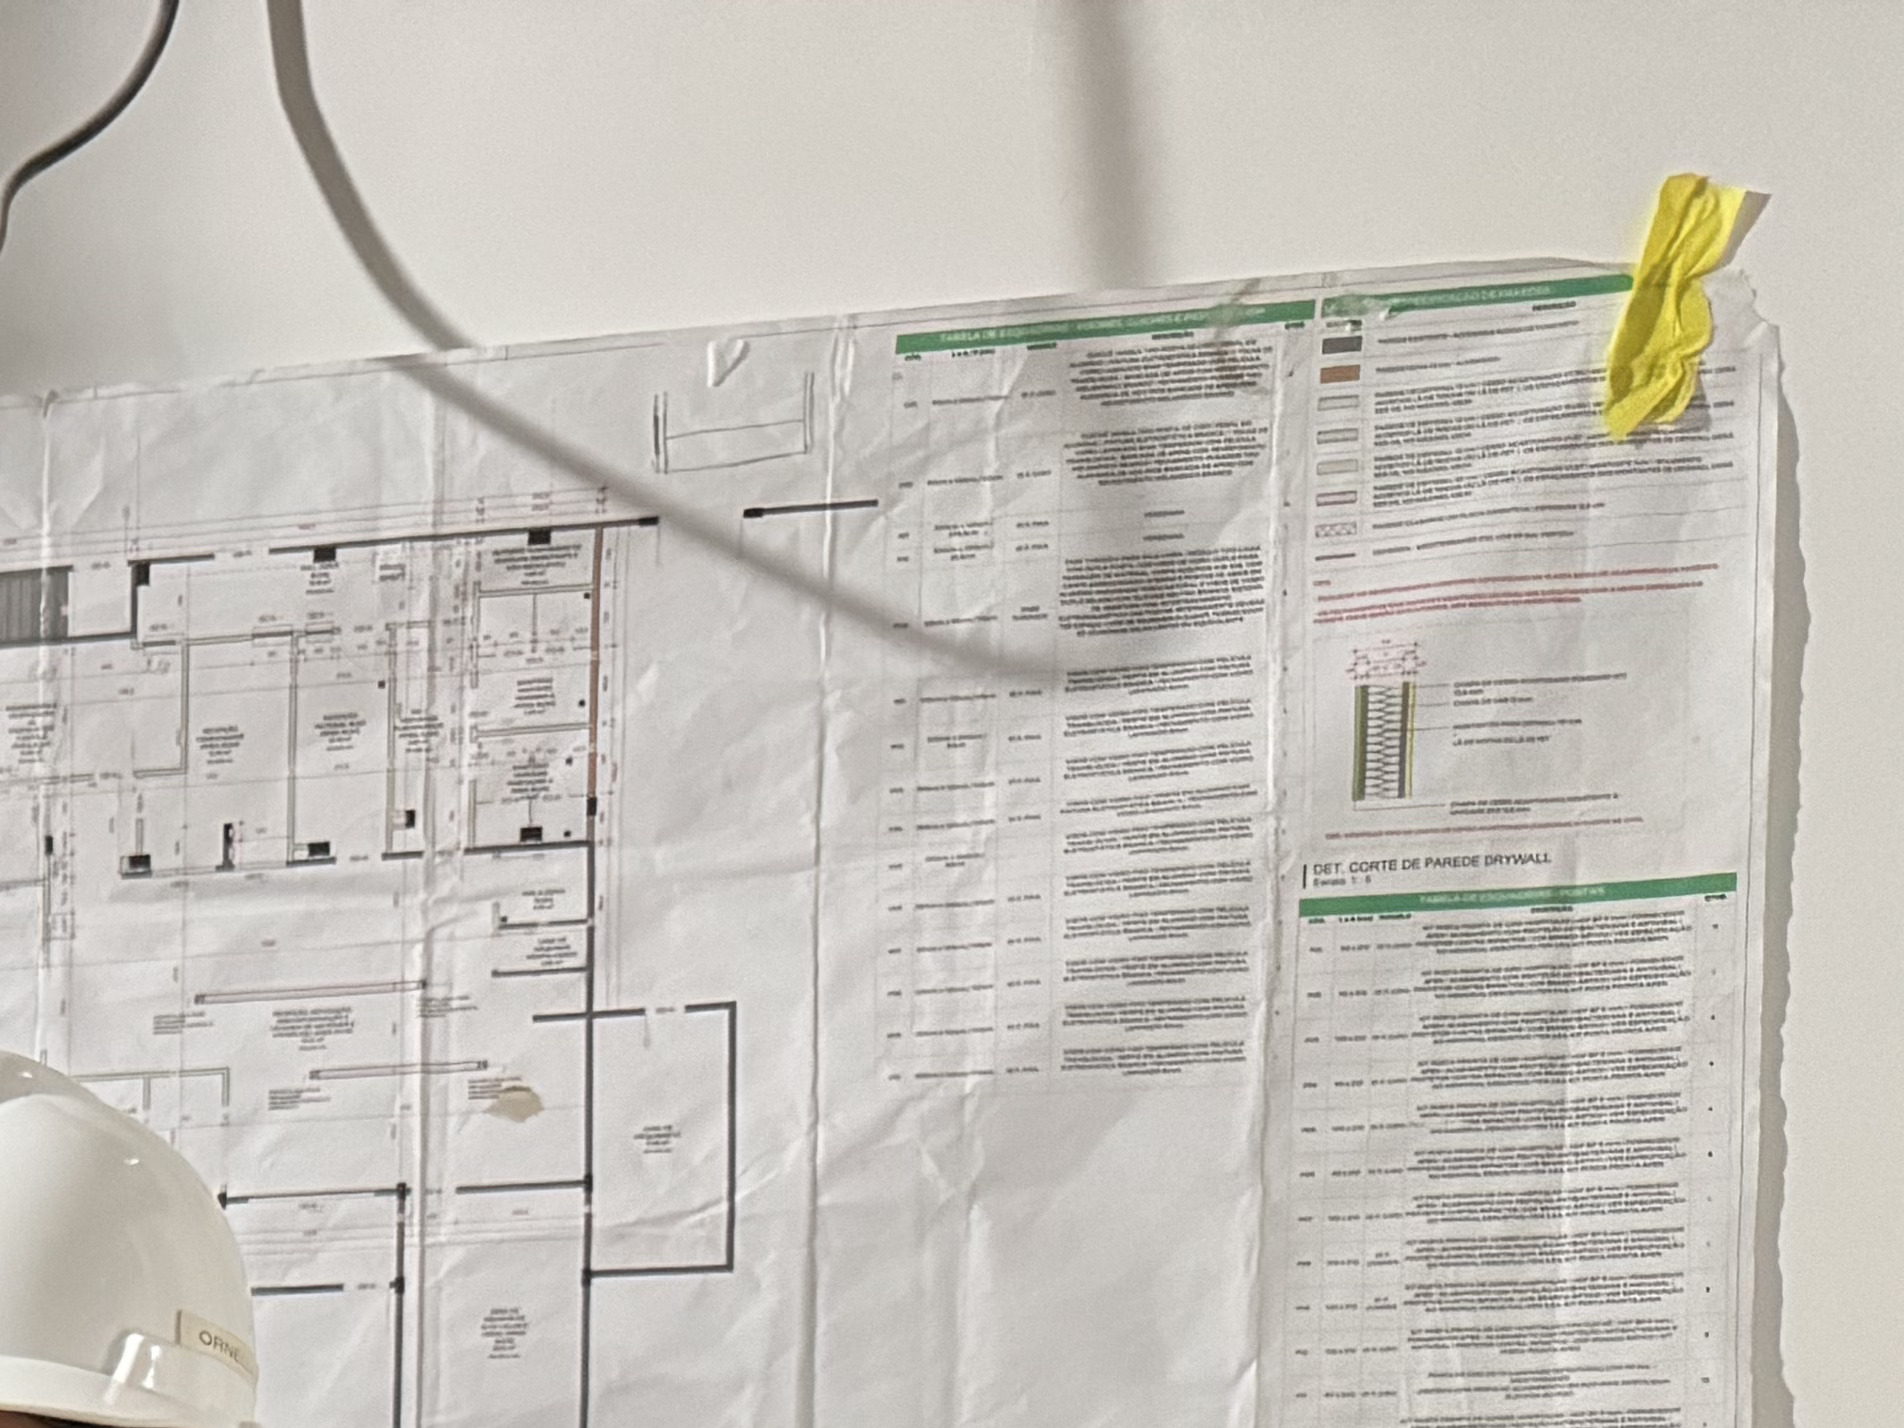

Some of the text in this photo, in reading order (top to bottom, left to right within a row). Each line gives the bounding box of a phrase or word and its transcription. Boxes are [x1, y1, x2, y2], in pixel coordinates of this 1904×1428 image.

[1349, 859, 1397, 874] CORTE
[1401, 858, 1420, 870] DE
[1425, 855, 1480, 869] PAREDE
[1484, 853, 1552, 867] DRYWALL
